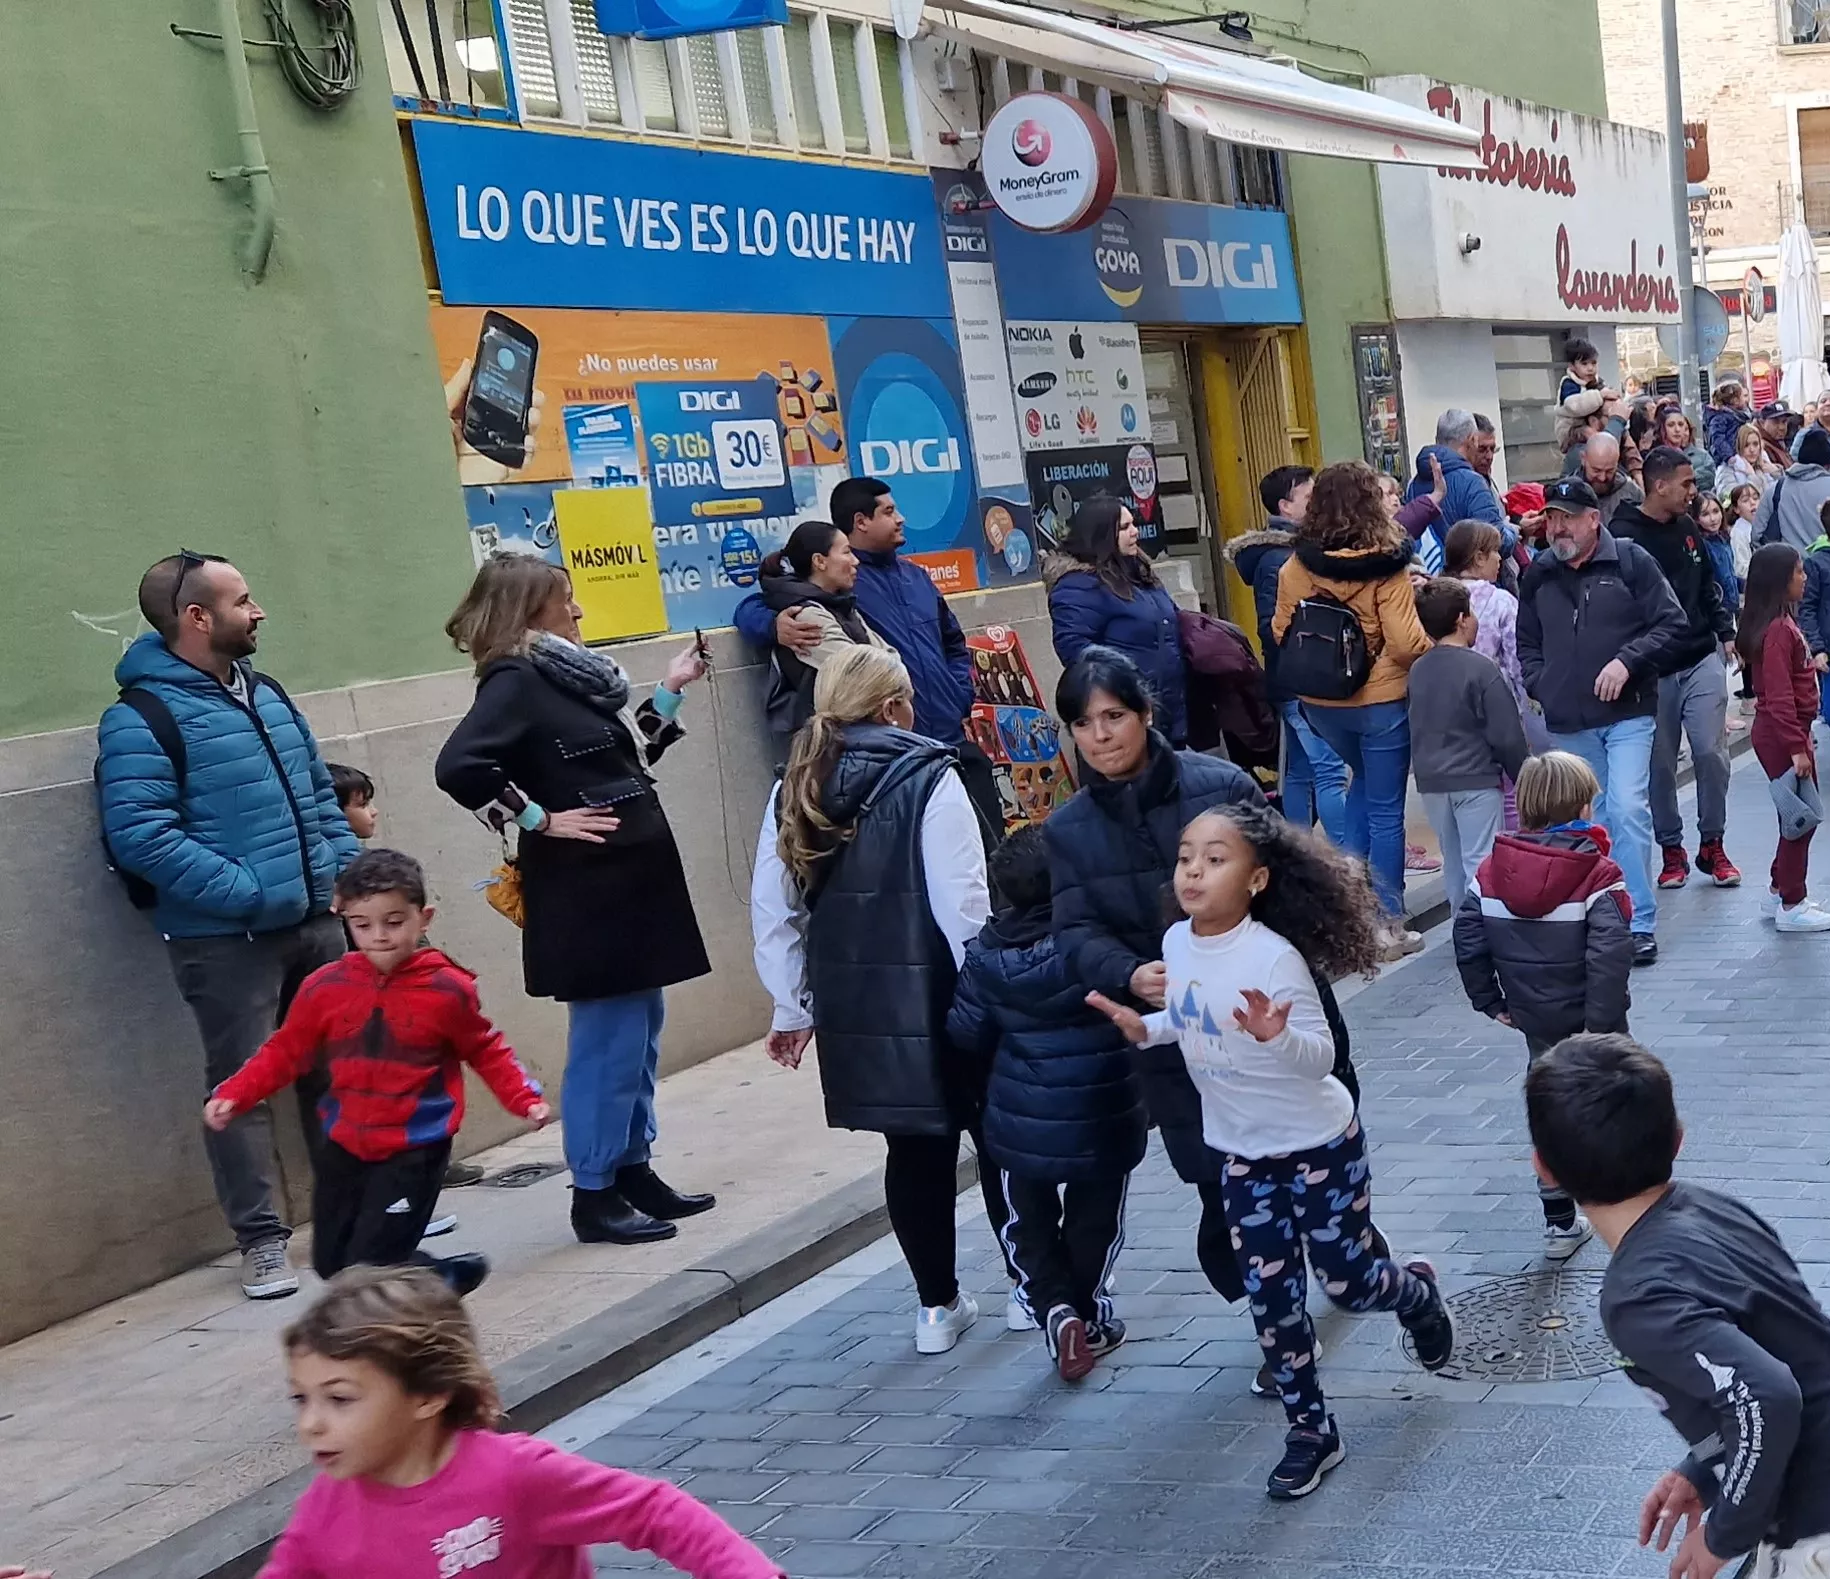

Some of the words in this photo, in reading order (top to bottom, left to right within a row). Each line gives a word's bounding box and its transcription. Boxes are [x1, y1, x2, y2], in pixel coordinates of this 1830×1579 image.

[1427, 87, 1576, 198] Ttoreria
[1000, 169, 1079, 192] MoneyGram
[456, 184, 510, 242] LO
[522, 190, 606, 247] QUE
[614, 197, 682, 252] VES
[691, 203, 728, 255] ES
[738, 208, 777, 257] LO
[787, 212, 852, 262] QUE
[858, 220, 916, 265] HAY
[946, 236, 987, 252] DIGI
[1095, 247, 1141, 275] GOYA
[1163, 237, 1278, 289] DIGI
[1555, 222, 1680, 313] lavanderia
[1008, 327, 1052, 341] NOKIA
[578, 353, 612, 376] ¿No
[617, 354, 679, 376] puedes
[684, 355, 719, 372] usar
[679, 390, 742, 412] DIGI
[1044, 413, 1061, 430] LG
[672, 431, 711, 458] 1Gb
[859, 437, 962, 476] DIGI
[655, 461, 717, 488] FIBRA
[1043, 459, 1109, 482] LIBERACIÓN
[1736, 1405, 1749, 1439] Space
[1748, 1400, 1765, 1451] National
